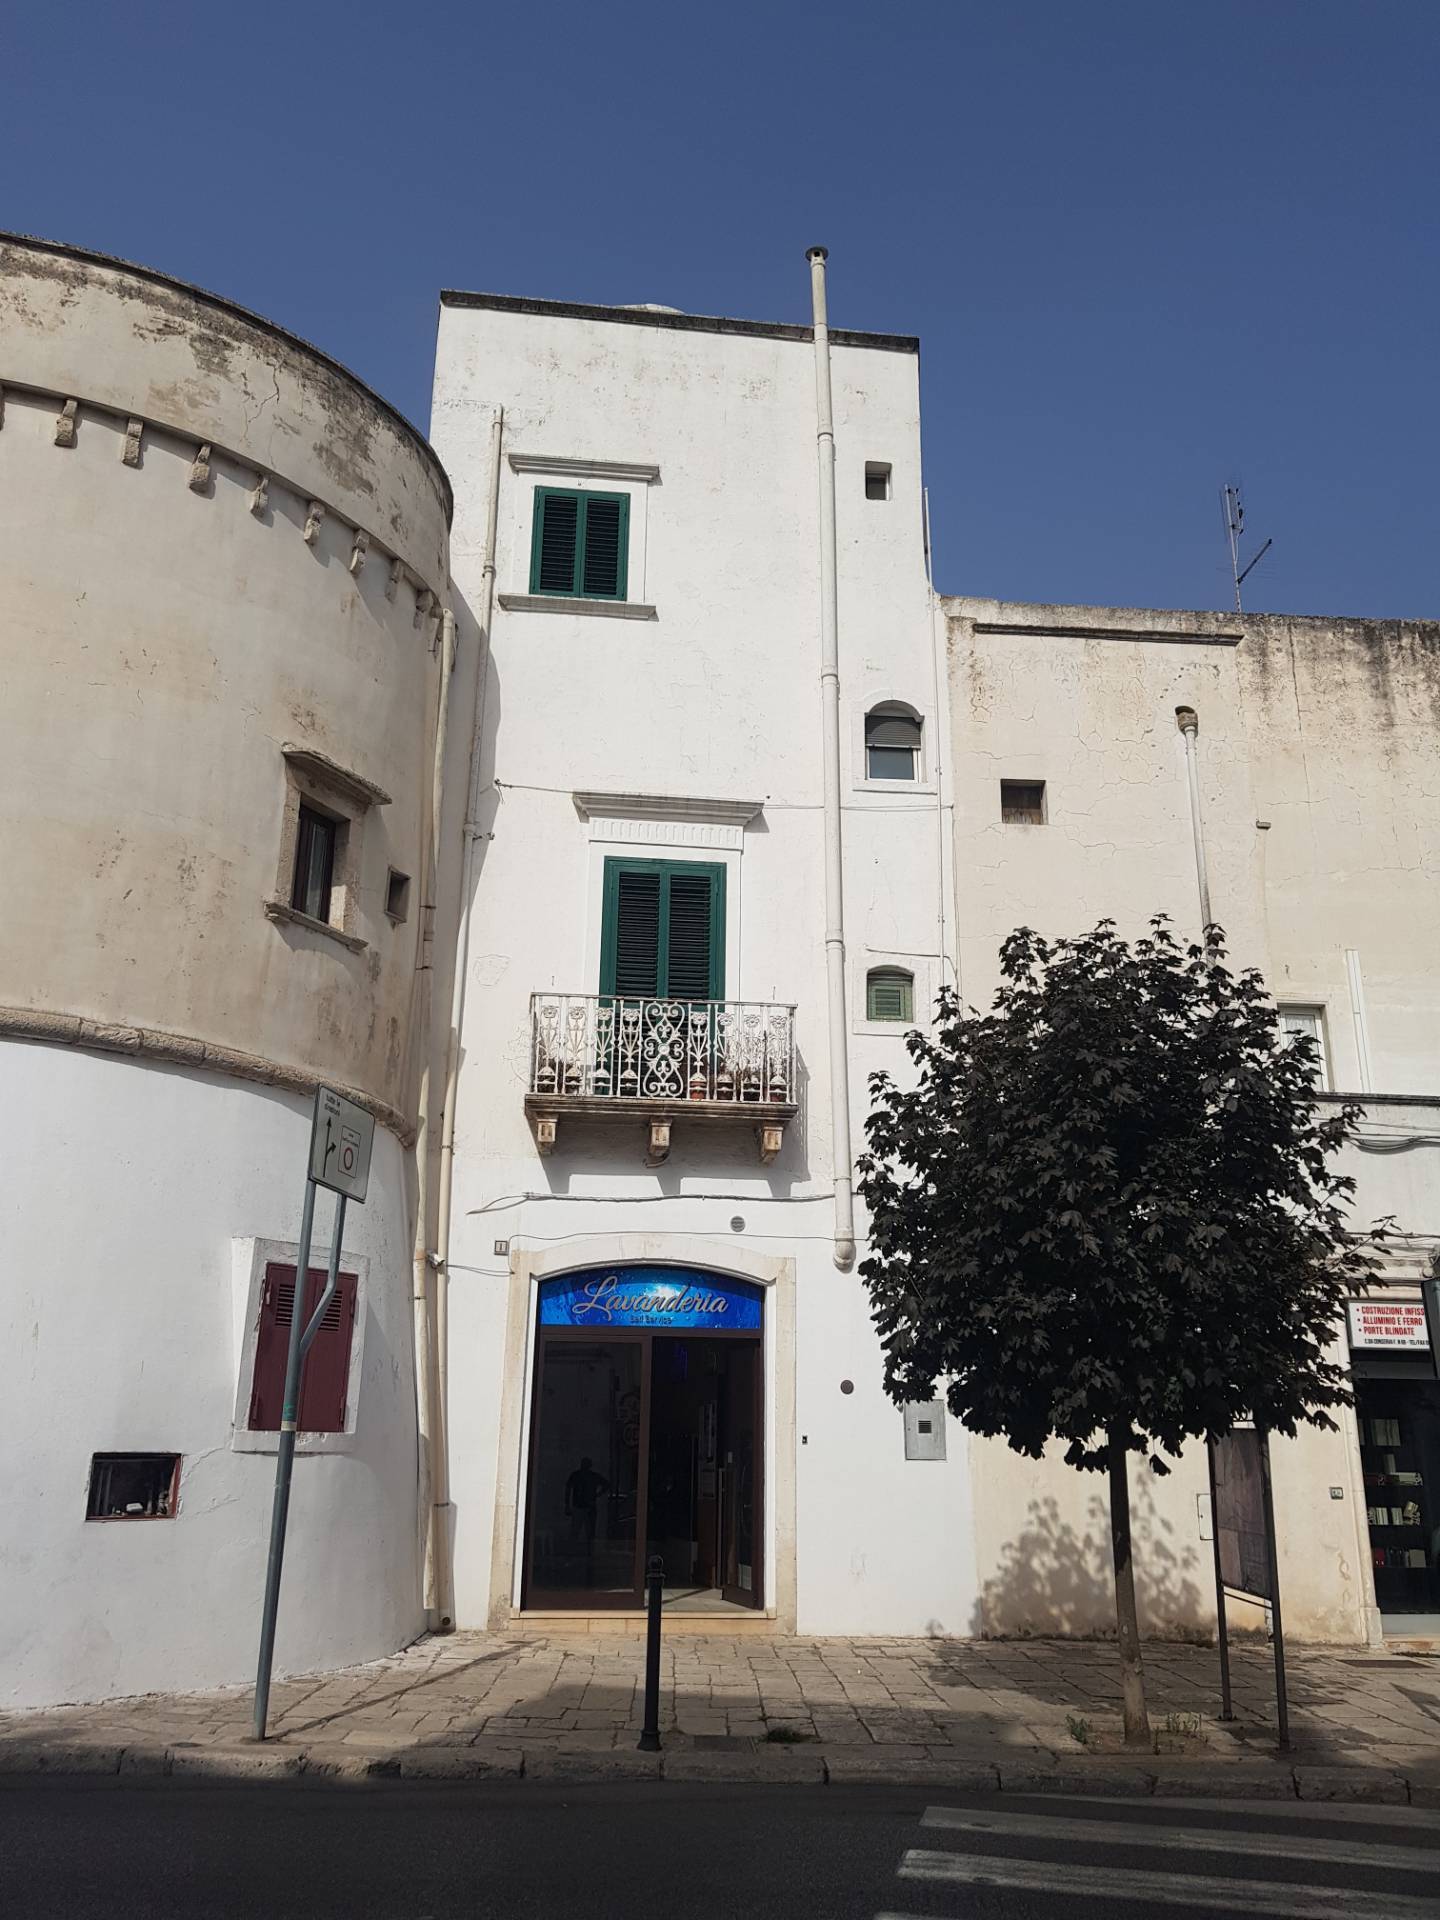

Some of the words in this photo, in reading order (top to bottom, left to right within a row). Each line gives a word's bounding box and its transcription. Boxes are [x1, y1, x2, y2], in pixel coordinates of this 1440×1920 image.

[572, 1275, 729, 1322] Lavanderia
[1361, 1306, 1403, 1316] COSTRUZIONE
[1404, 1307, 1425, 1316] INFISS
[1362, 1316, 1396, 1326] ALLUMINIO
[1397, 1317, 1402, 1326] E
[1402, 1317, 1423, 1326] FERRO
[1363, 1326, 1383, 1335] PORTE
[1384, 1327, 1415, 1336] BLINDATE
